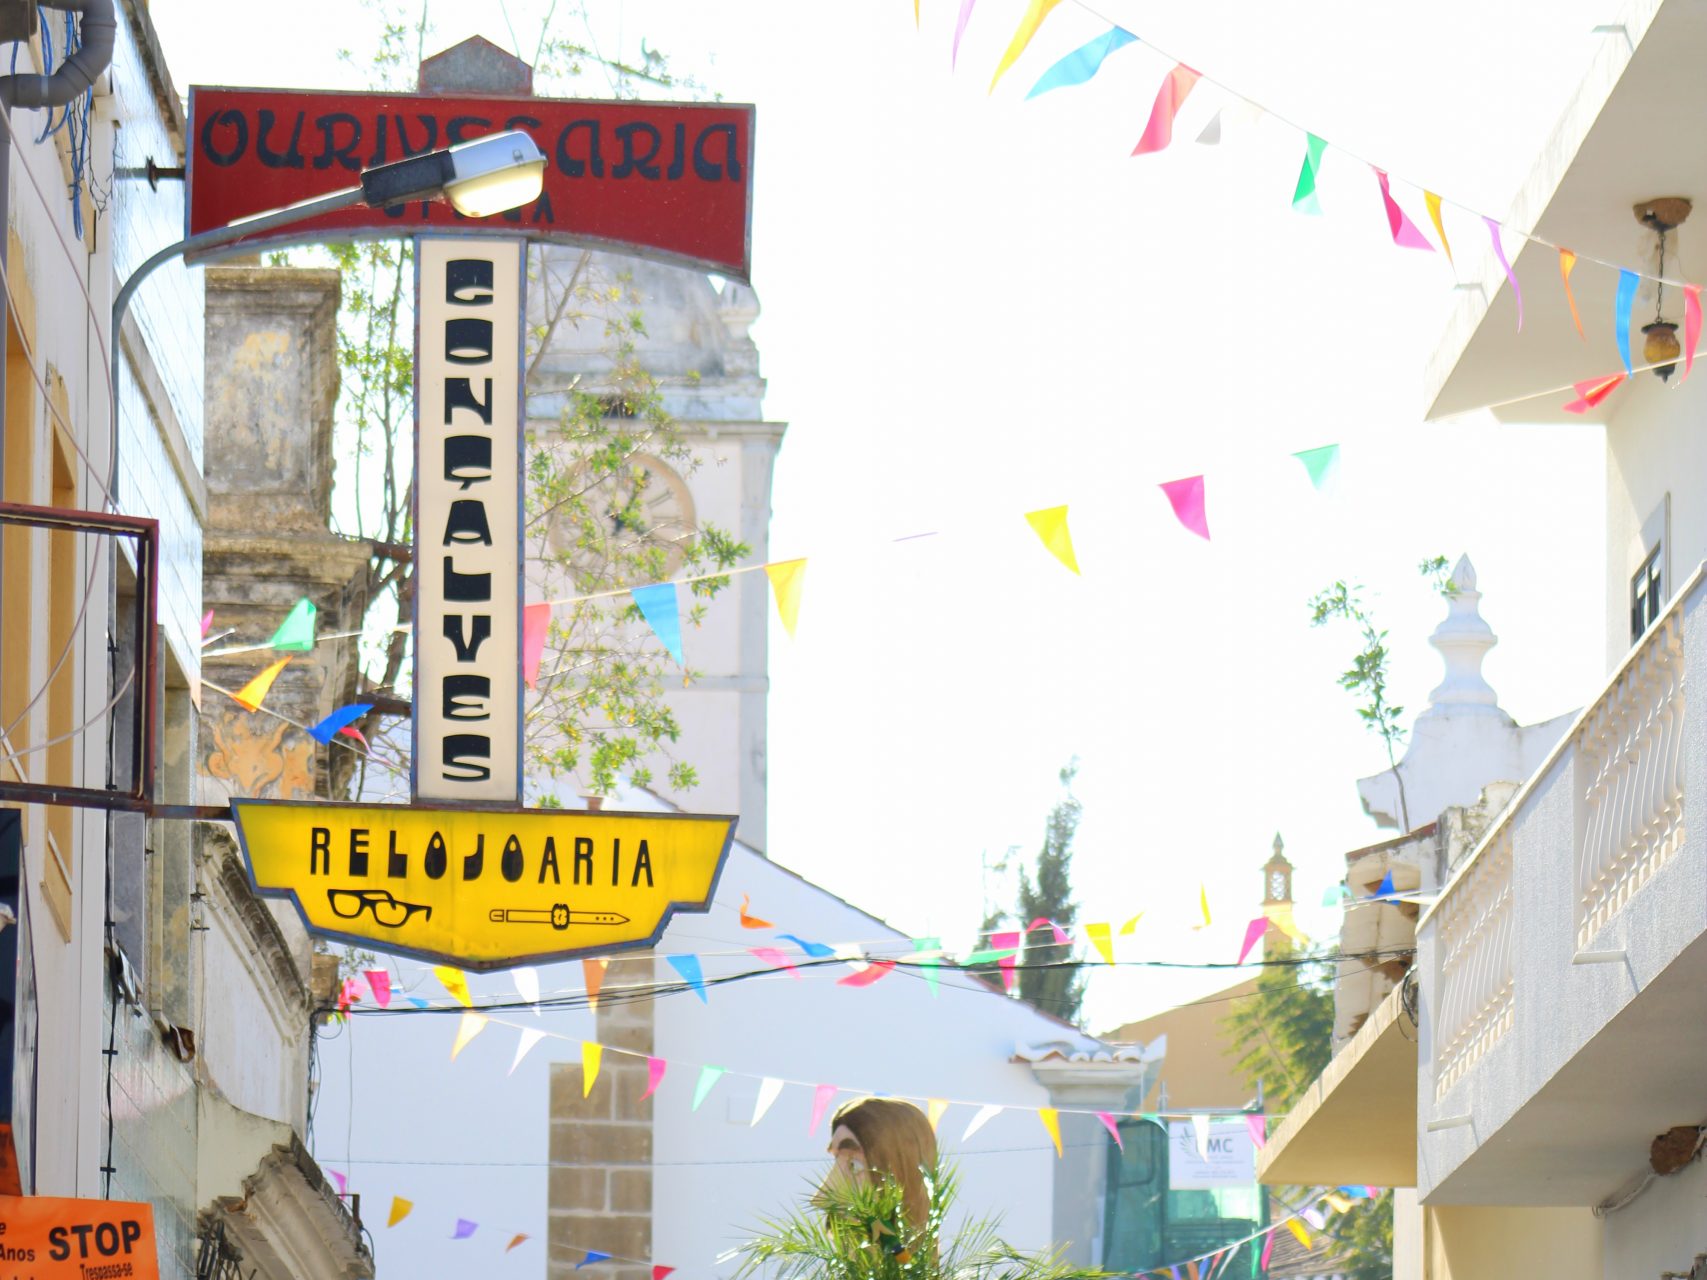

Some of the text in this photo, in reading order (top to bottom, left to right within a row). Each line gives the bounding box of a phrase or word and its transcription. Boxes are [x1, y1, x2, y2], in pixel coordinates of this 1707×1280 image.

[443, 259, 494, 783] GONÇALVES
[310, 827, 655, 888] RELOJOARIA
[1195, 1137, 1233, 1154] MC
[49, 1220, 142, 1262] STOP
